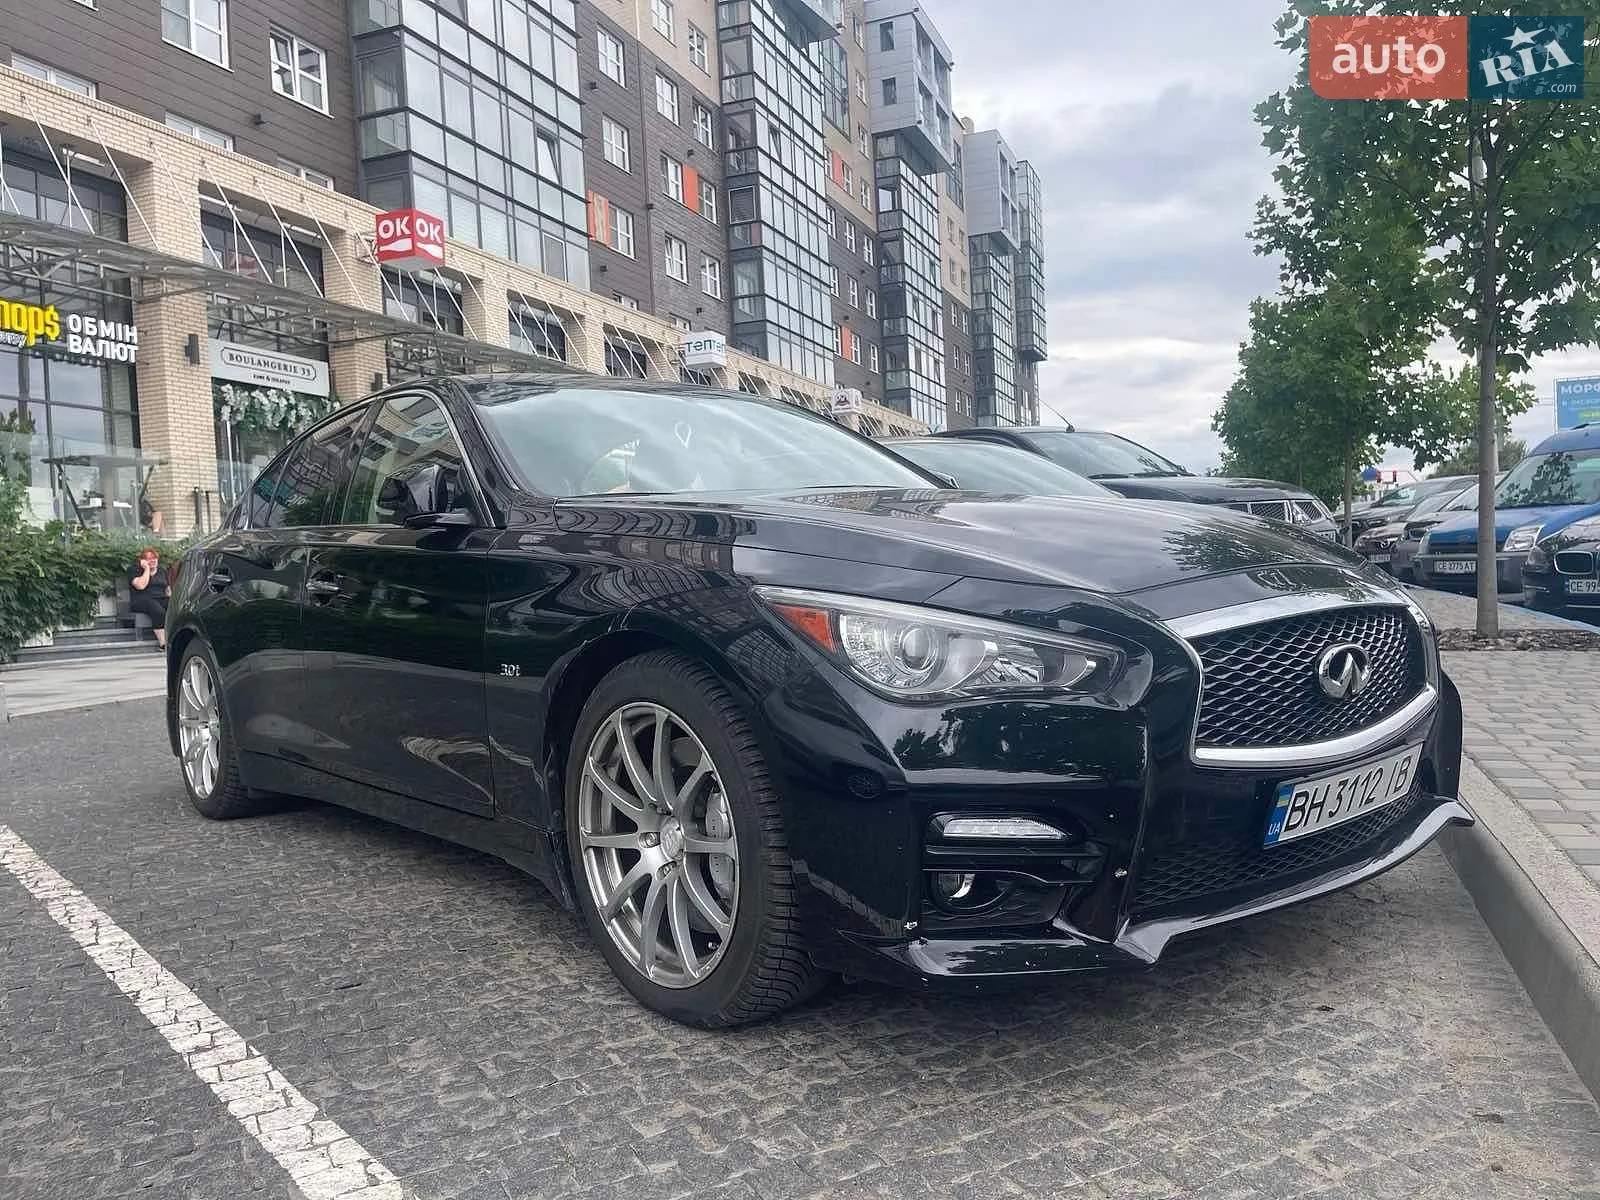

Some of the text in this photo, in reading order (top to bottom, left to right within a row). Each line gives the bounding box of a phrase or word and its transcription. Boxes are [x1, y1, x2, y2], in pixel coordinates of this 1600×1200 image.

[378, 216, 412, 239] OK
[415, 217, 442, 243] OK
[67, 313, 138, 344] ОБМІН
[67, 334, 139, 363] ВАЛЮТ
[228, 353, 298, 374] BOULANGERIE
[1283, 755, 1414, 832] BH 3112 IB
[1267, 821, 1282, 836] UA
